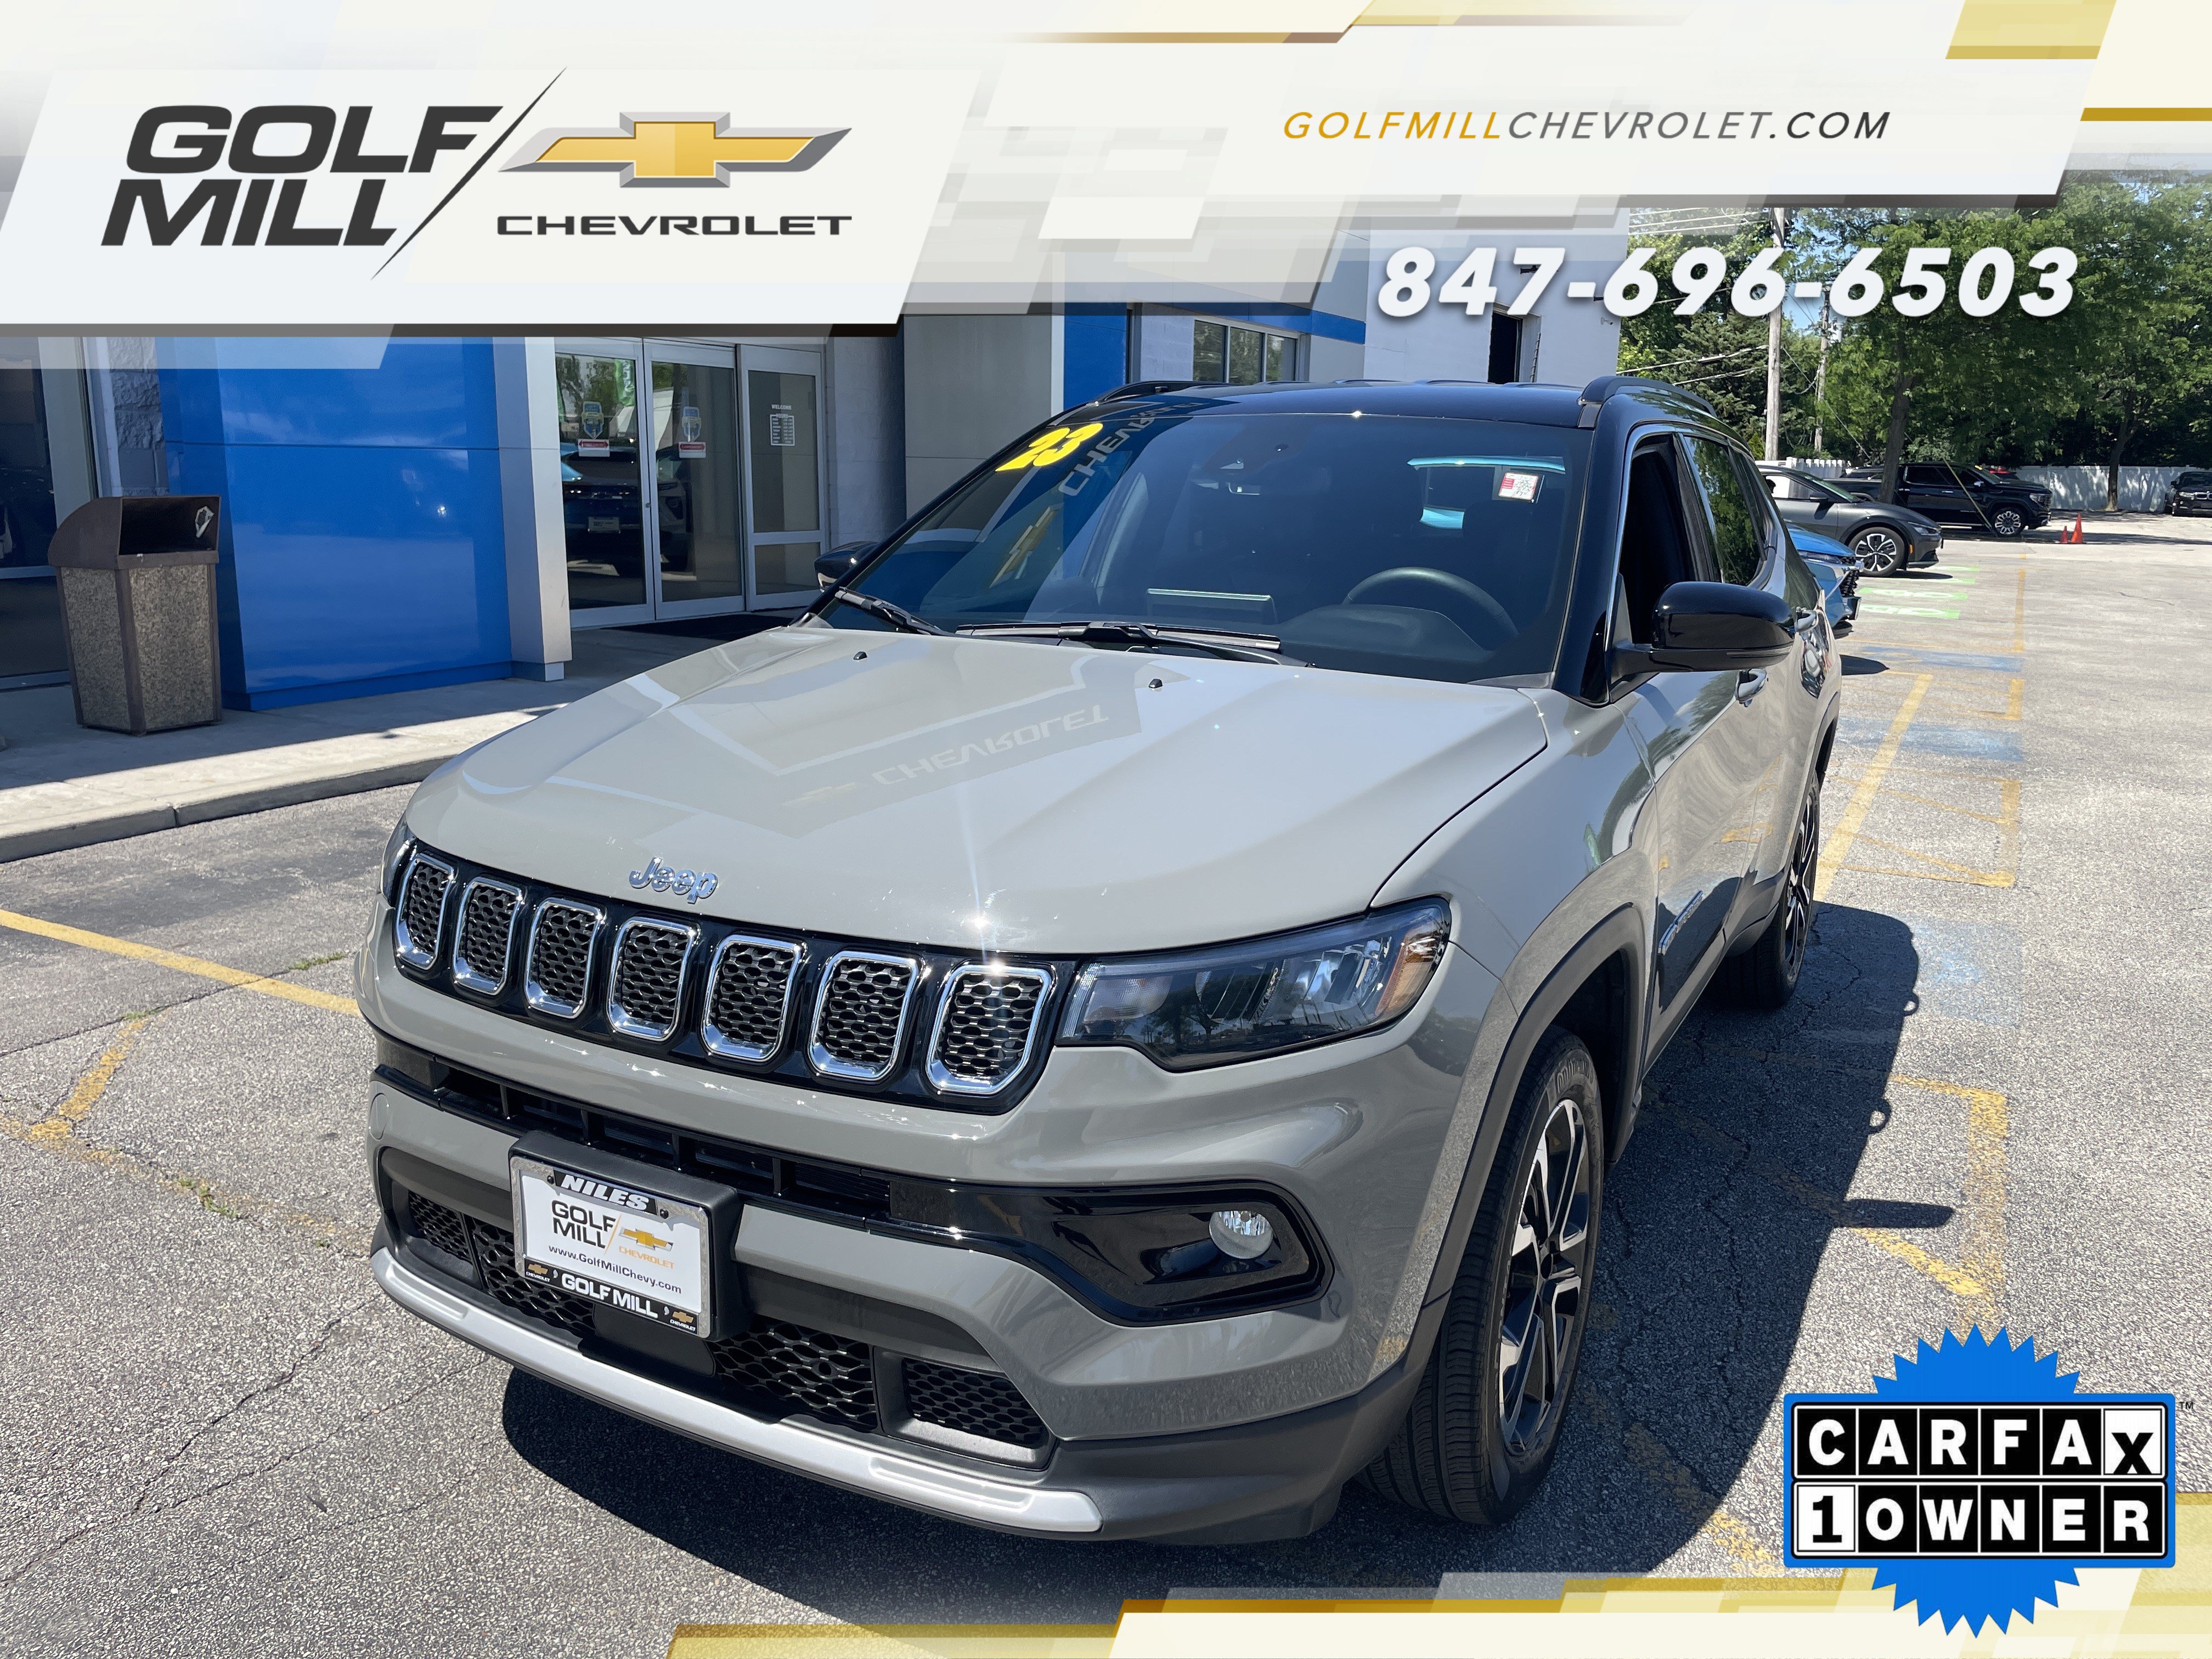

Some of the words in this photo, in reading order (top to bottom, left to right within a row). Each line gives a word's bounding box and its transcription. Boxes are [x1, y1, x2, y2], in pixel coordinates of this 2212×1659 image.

[996, 423, 1103, 472] 23
[629, 857, 719, 904] Jeep
[561, 1174, 649, 1211] NILES
[551, 1200, 616, 1232] GOLF
[552, 1217, 606, 1249] MILL
[549, 1245, 681, 1294] www.GolfMillChevy.com
[619, 1245, 675, 1269] CHEVROLET
[526, 1271, 550, 1283] CHEVROLET
[562, 1273, 611, 1300] GOLF
[613, 1289, 658, 1319] MILL
[670, 1319, 696, 1331] CHEVROLET
